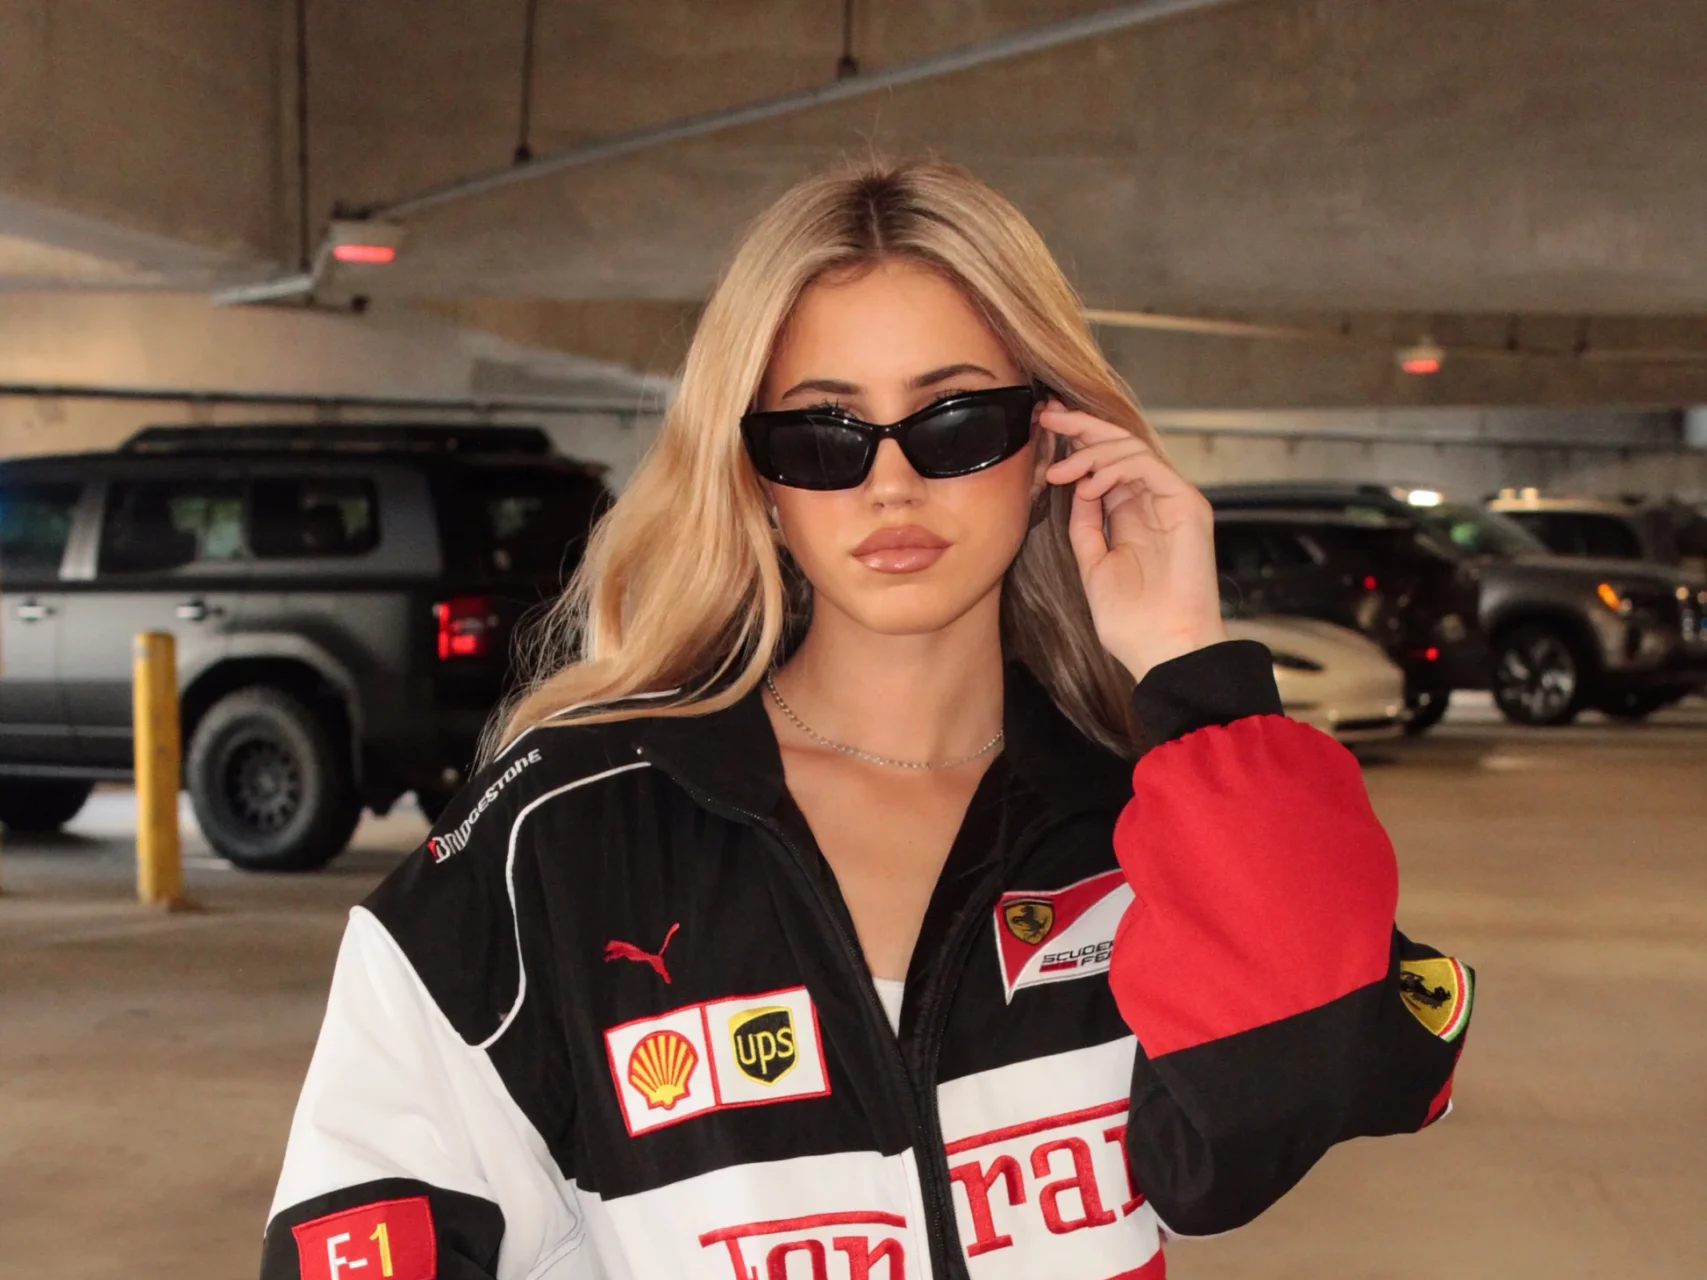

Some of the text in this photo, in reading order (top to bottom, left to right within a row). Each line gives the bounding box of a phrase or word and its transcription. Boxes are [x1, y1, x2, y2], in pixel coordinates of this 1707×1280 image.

[427, 748, 542, 864] BRIDGESTONE
[1080, 949, 1112, 967] FE
[736, 1027, 794, 1075] ups
